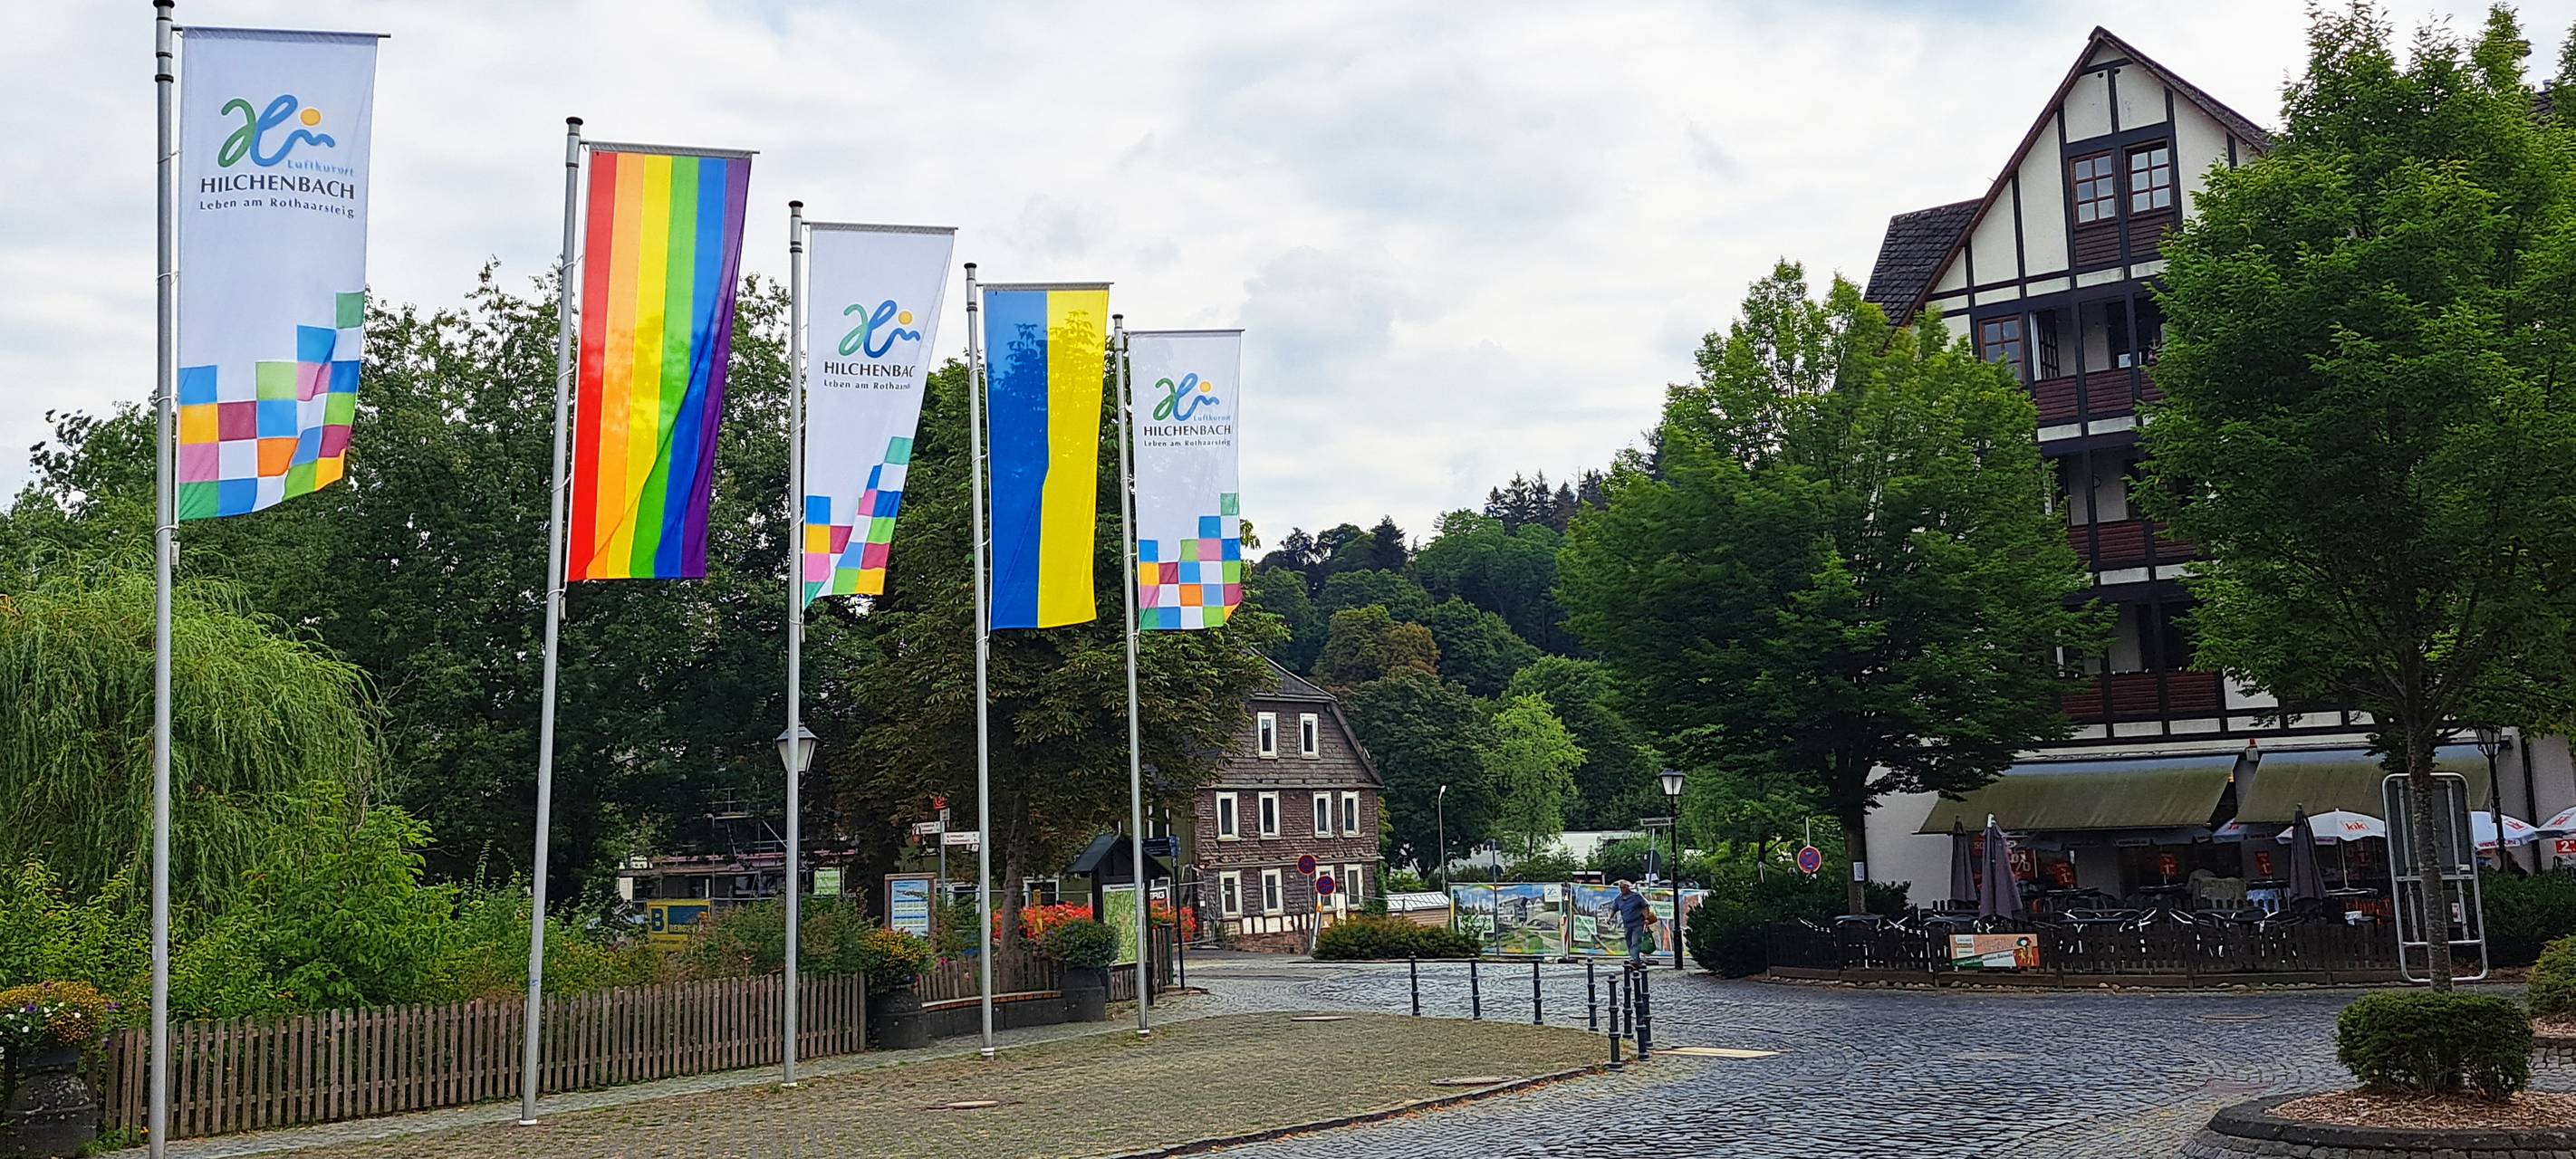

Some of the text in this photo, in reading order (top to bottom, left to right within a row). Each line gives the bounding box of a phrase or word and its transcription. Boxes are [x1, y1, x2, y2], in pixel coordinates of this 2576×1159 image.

[287, 158, 354, 177] Luftkurort
[200, 174, 355, 199] HILCHENBACH
[199, 197, 355, 219] Leben am Rothaarsteig
[823, 379, 851, 389] Leben
[1144, 424, 1231, 436] HILCHENBACH
